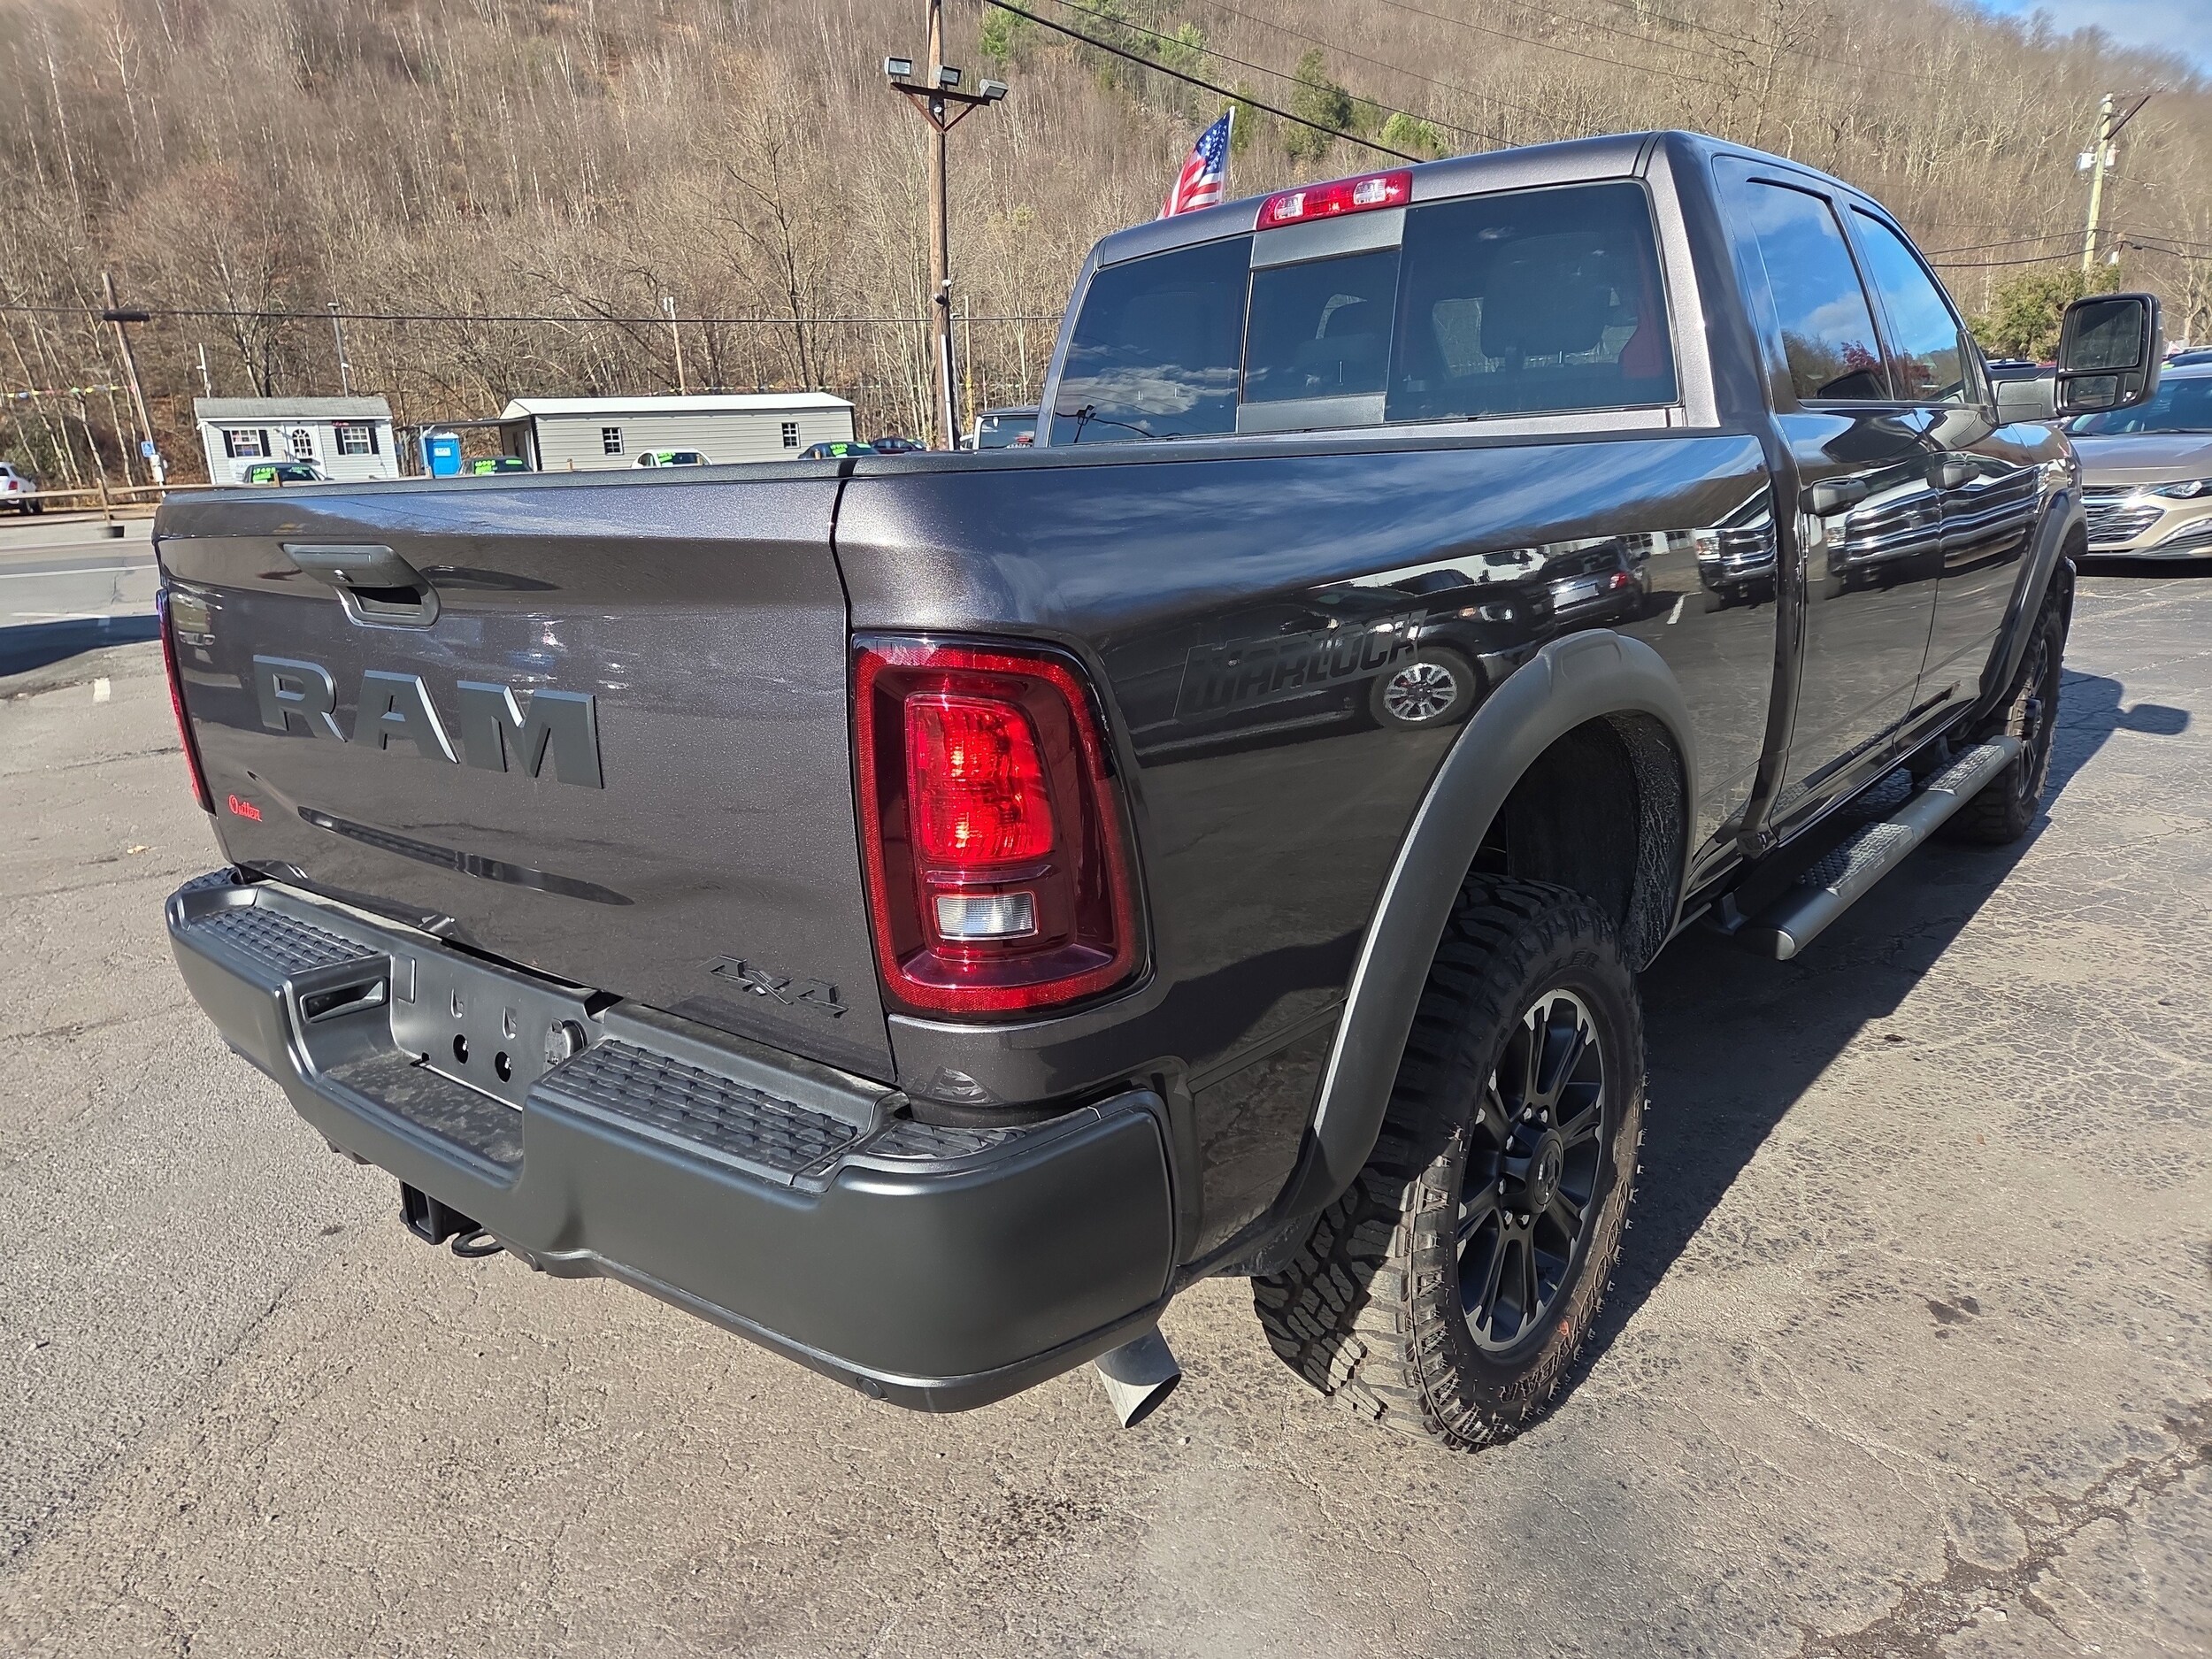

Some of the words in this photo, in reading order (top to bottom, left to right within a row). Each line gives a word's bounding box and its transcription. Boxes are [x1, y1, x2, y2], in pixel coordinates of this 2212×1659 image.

[252, 654, 604, 790] RAM
[1175, 609, 1430, 717] WARLOCK
[1498, 1179, 1630, 1405] GOODYEAR
